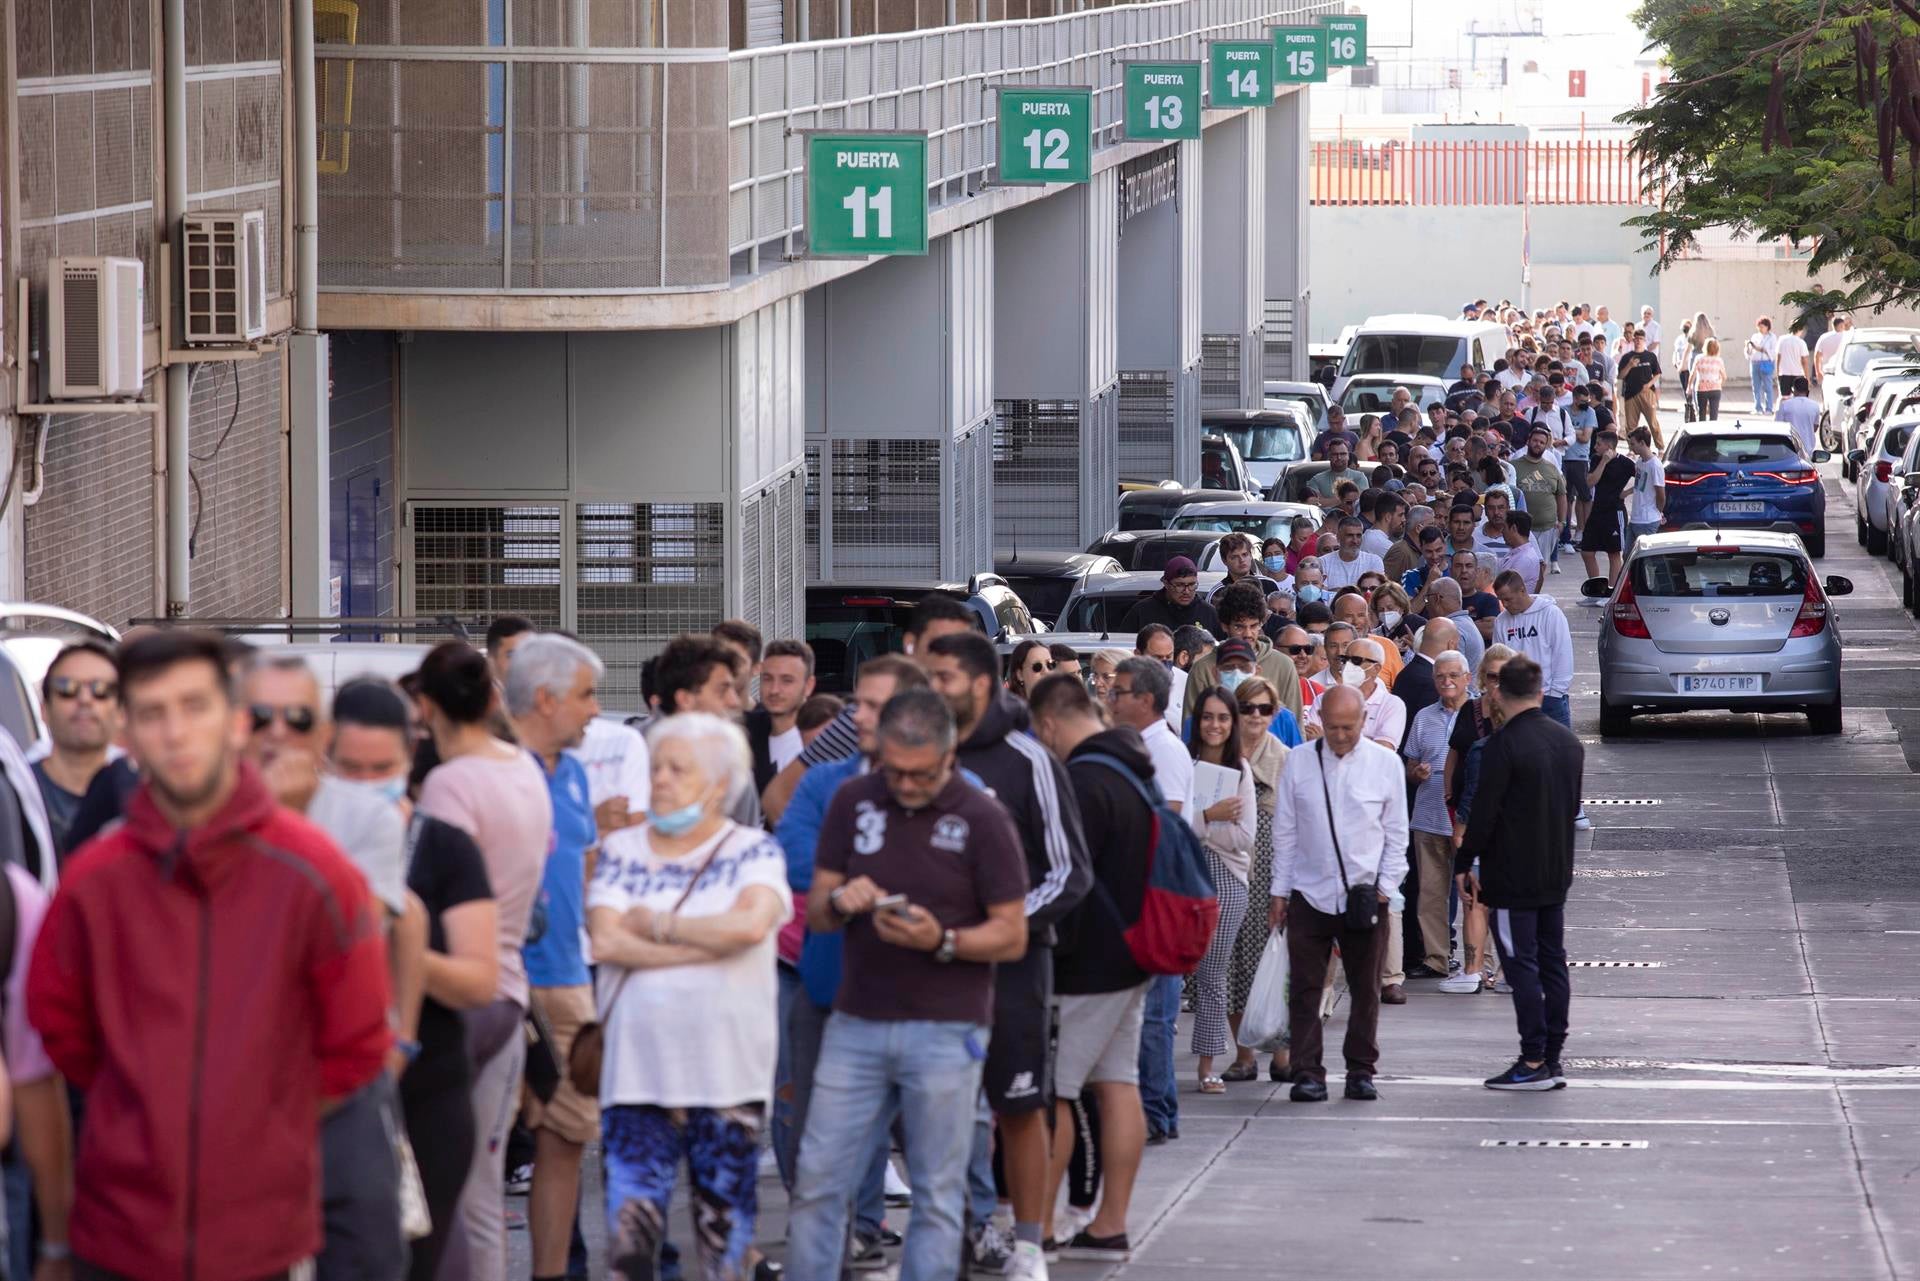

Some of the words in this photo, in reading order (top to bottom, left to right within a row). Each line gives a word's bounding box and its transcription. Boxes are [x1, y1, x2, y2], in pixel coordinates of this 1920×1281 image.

[1330, 23, 1357, 31] PUERTA
[1286, 35, 1316, 43] PUERTA
[1226, 51, 1261, 61] PUERTA
[1330, 36, 1356, 60] 16
[1286, 50, 1315, 76] 15
[1144, 74, 1184, 85] PUERTA
[1226, 69, 1260, 98] 14
[1022, 102, 1071, 116] PUERTA
[1144, 95, 1183, 129] 13
[1023, 128, 1070, 170] 12
[836, 151, 900, 169] PUERTA
[843, 186, 893, 238] 11
[1507, 625, 1539, 642] FILA
[1693, 677, 1726, 690] 3740
[1729, 677, 1754, 690] FWP
